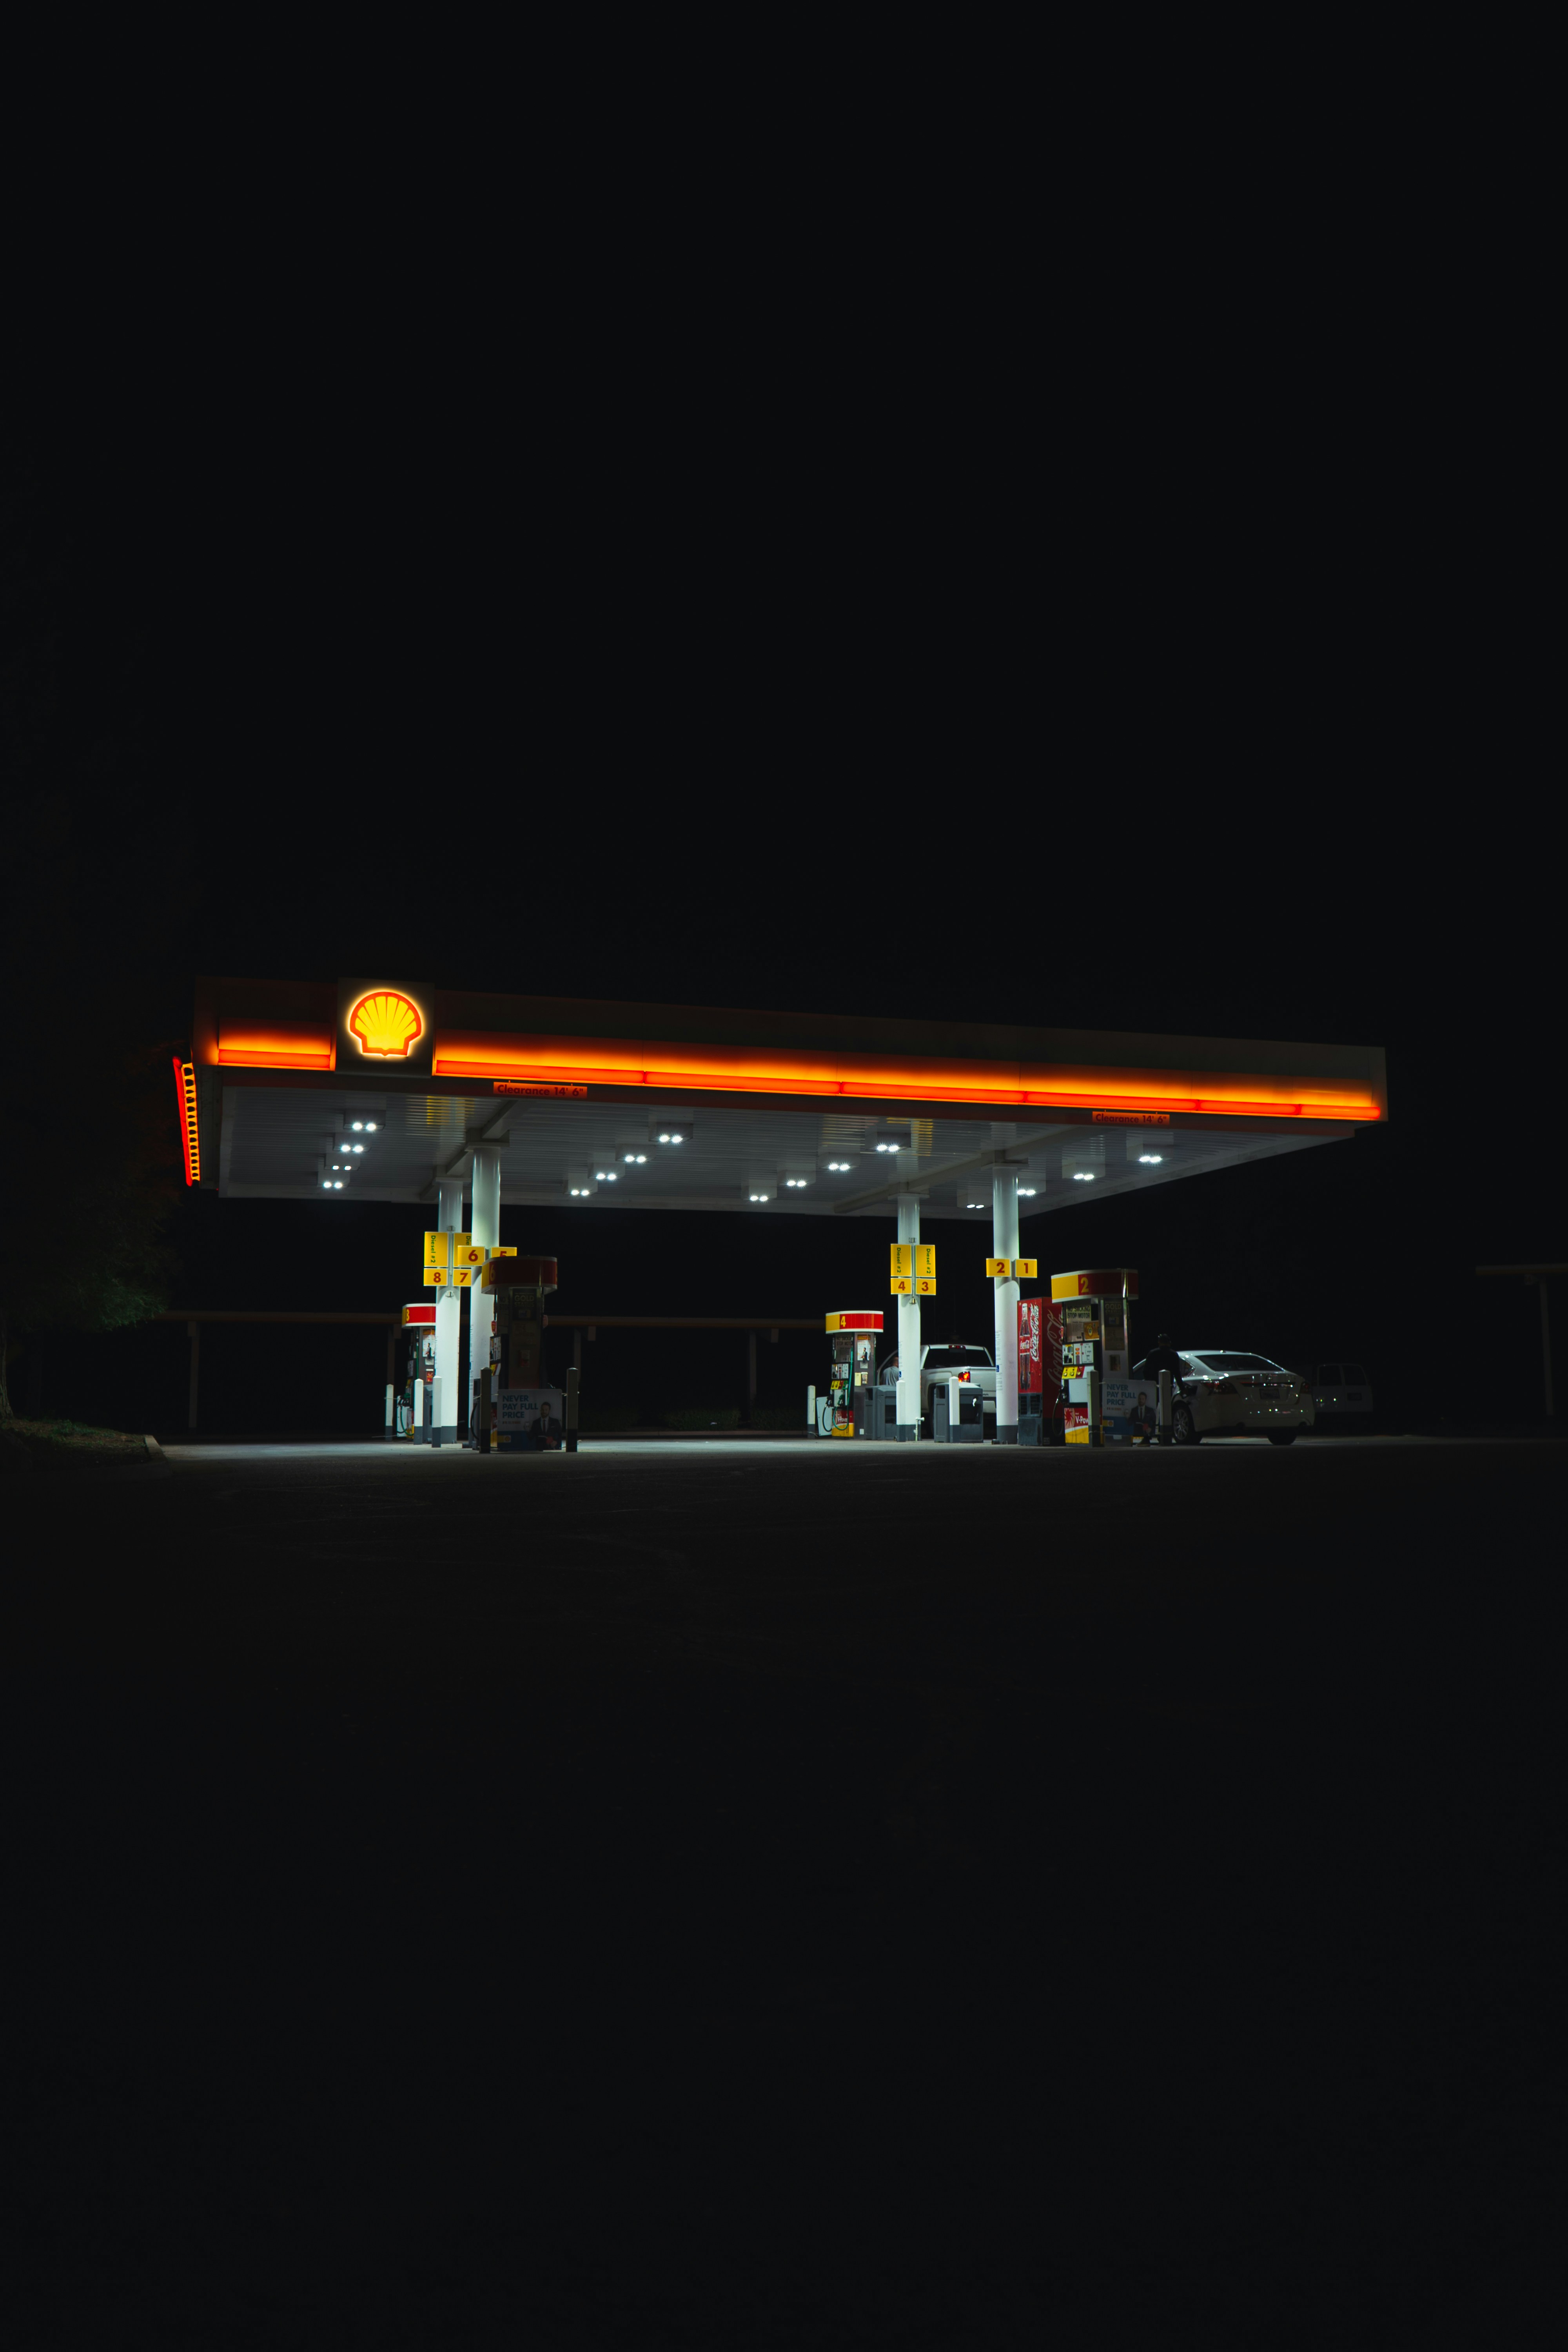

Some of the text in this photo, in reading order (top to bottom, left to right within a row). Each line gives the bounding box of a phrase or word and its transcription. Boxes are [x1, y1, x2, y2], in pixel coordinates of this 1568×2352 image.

[497, 1084, 583, 1096] Clearance 14' 6"
[1096, 1113, 1139, 1123] Clearance
[468, 1250, 478, 1262] 6
[490, 1264, 495, 1282] 6
[996, 1262, 1005, 1274] 2
[1024, 1263, 1029, 1274] 1
[433, 1272, 441, 1283] 8
[460, 1272, 468, 1283] 7
[898, 1281, 906, 1291] 4
[921, 1281, 929, 1292] 3
[1080, 1277, 1089, 1293] 2
[406, 1308, 410, 1322] 8
[840, 1316, 846, 1327] 4
[1030, 1303, 1039, 1361] Coca-Cola
